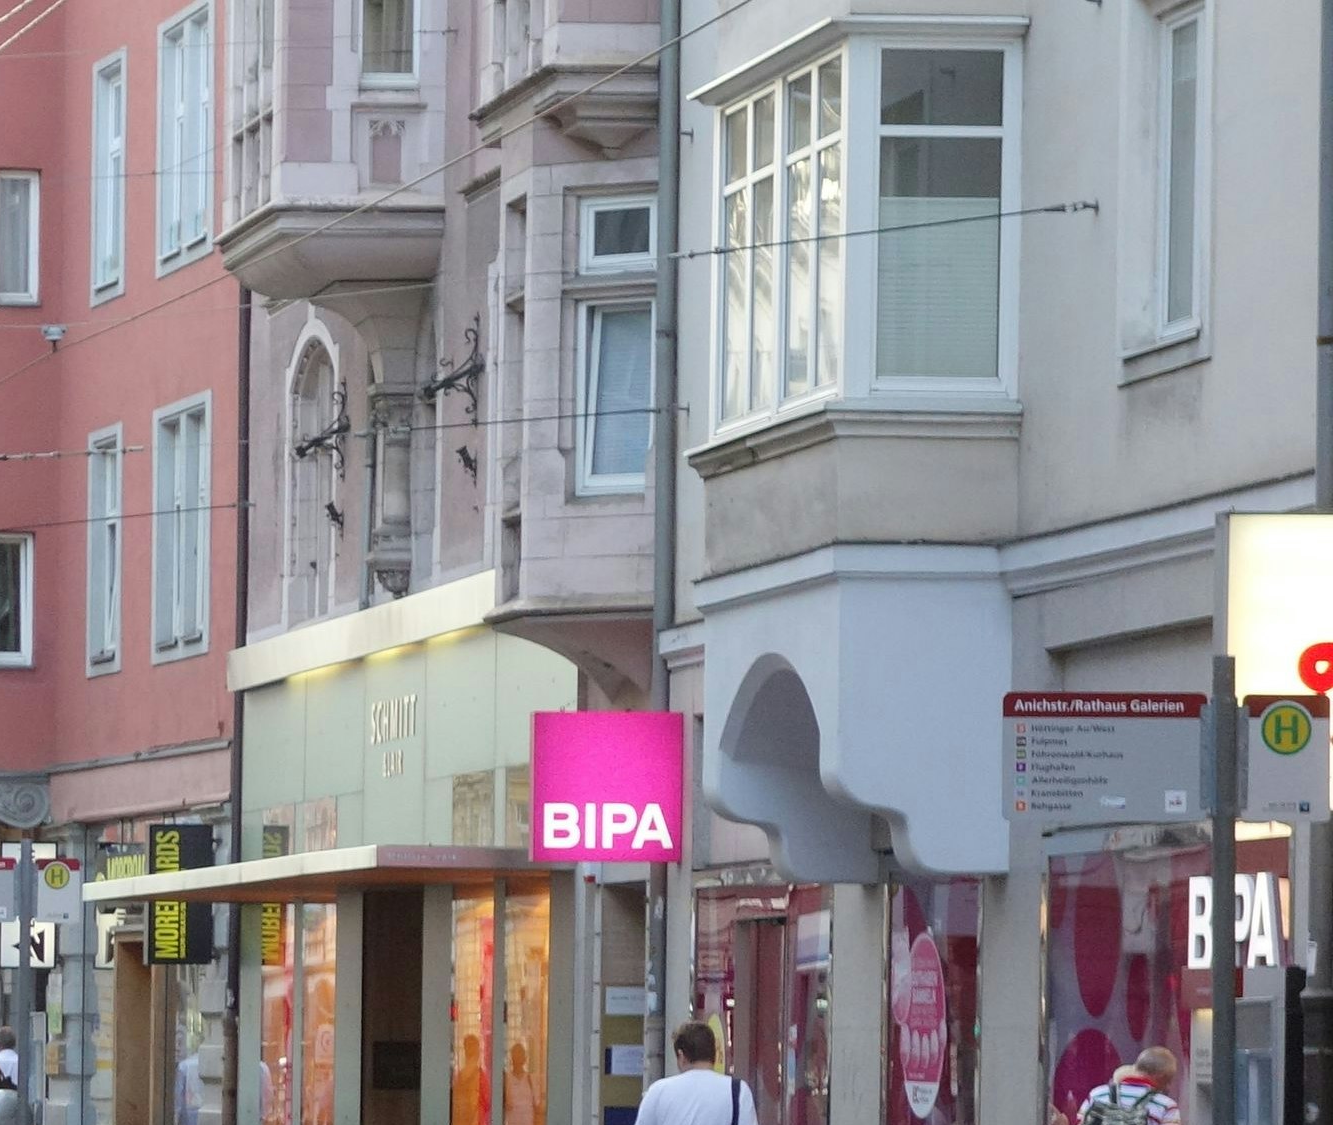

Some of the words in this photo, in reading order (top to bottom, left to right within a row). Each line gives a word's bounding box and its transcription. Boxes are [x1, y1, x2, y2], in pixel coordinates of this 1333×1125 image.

[1014, 698, 1127, 713] Anichstr./Rathaus
[1130, 699, 1185, 713] Galerien
[1274, 714, 1299, 744] H
[543, 802, 674, 849] BIPA
[51, 869, 64, 884] H
[1187, 872, 1276, 970] BPA
